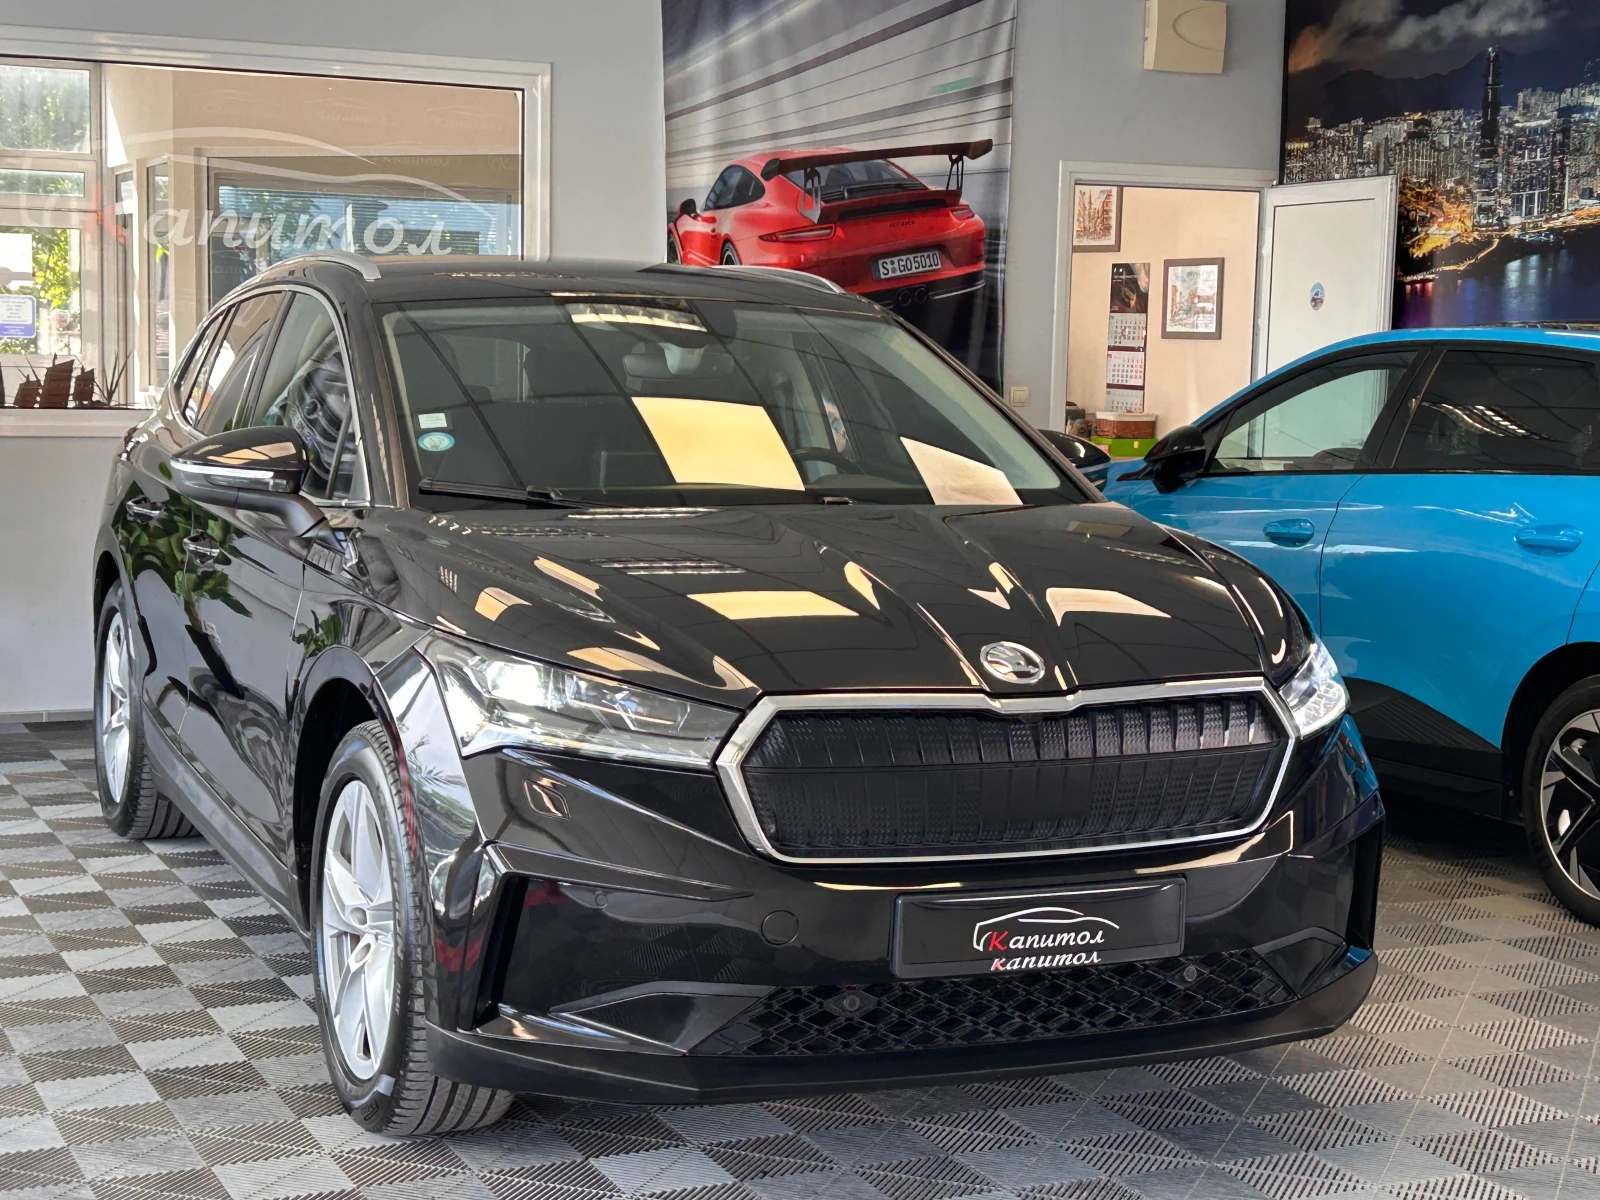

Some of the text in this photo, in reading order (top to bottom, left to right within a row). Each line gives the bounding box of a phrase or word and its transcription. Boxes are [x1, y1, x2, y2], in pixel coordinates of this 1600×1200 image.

[83, 181, 452, 256] Капитол
[989, 930, 1105, 951] Капитол
[991, 951, 1102, 971] капитол
